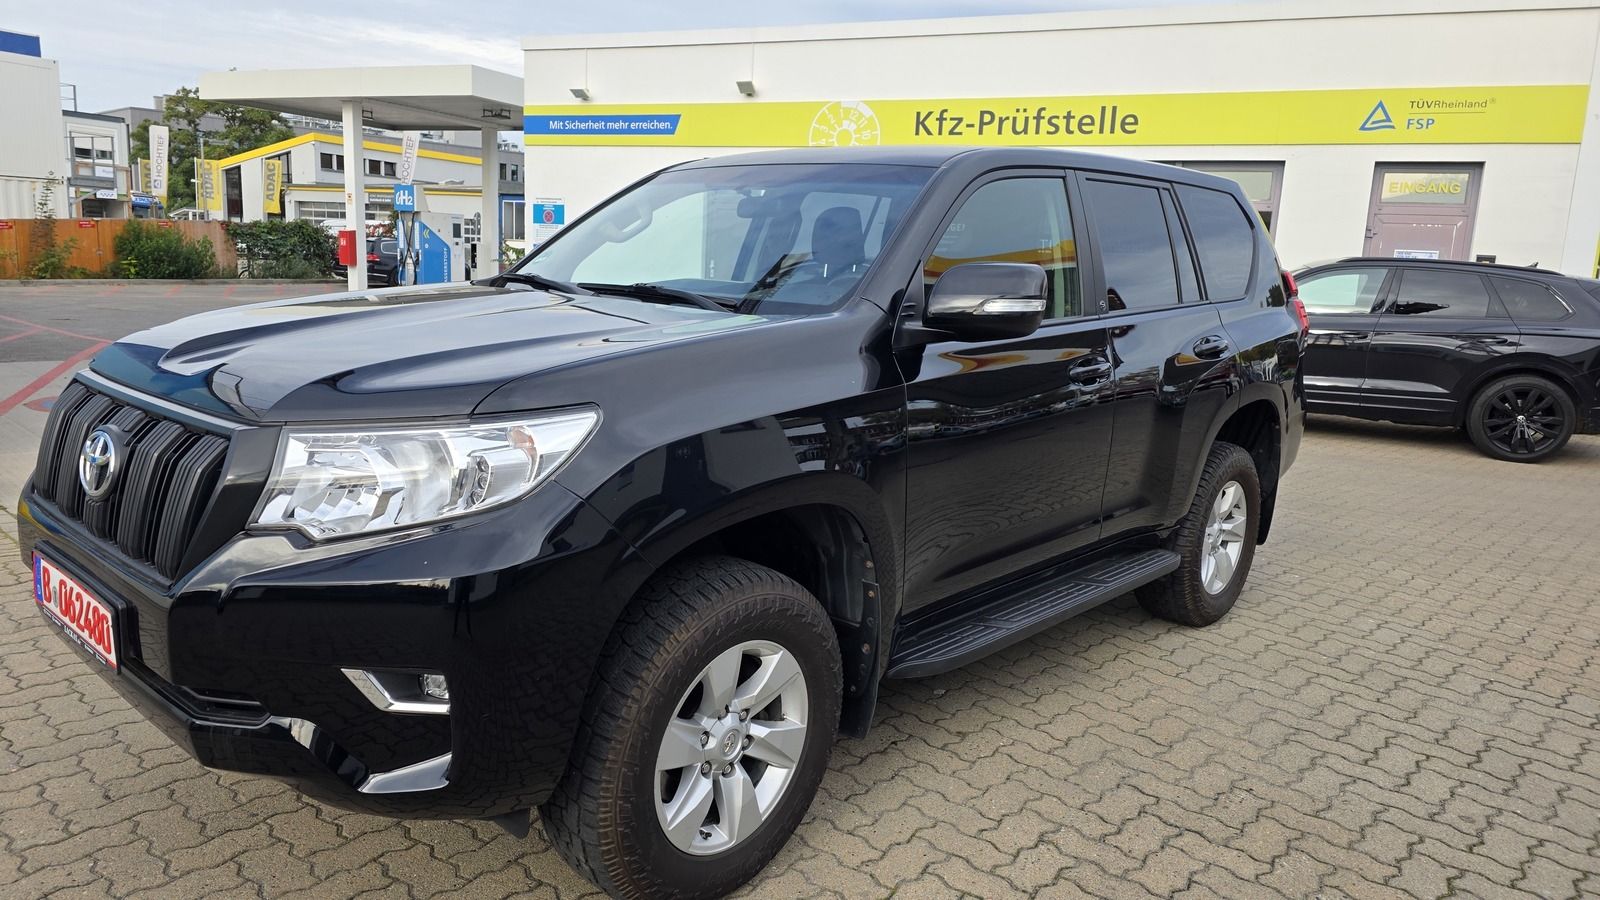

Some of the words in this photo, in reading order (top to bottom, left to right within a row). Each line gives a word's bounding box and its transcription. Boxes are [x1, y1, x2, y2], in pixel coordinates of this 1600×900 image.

[549, 120, 564, 130] Mit
[565, 120, 606, 130] Sicherheit
[606, 120, 629, 130] mehr
[630, 120, 673, 130] erreichen.
[914, 105, 1139, 137] Kfz-Prüfstelle
[1406, 118, 1435, 129] FSP
[156, 136, 165, 178] HOCHTIEF
[402, 136, 414, 184] HOCHTIEF
[265, 161, 276, 201] ADAC
[1389, 182, 1462, 194] EINGANG
[42, 566, 51, 603] B
[58, 579, 112, 655] 062480
